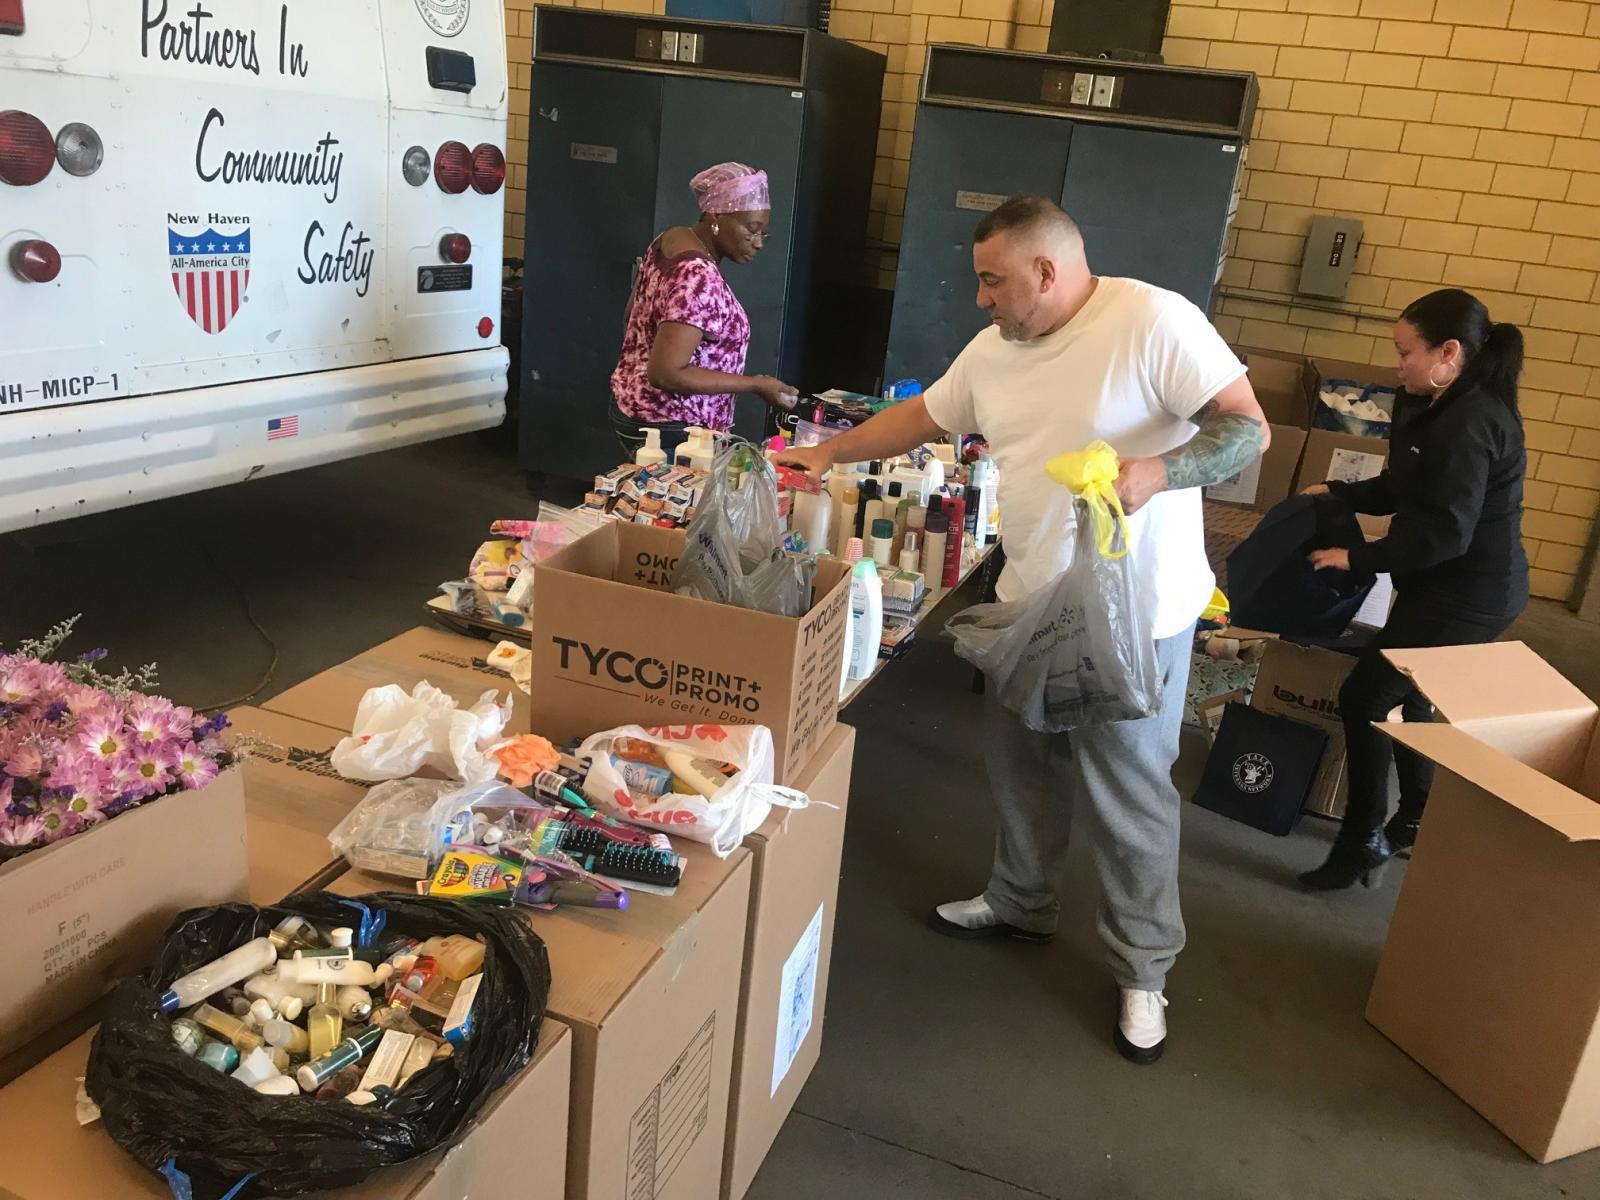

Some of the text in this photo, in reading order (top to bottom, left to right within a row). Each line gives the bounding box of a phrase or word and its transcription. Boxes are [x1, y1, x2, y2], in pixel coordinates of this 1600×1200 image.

[142, 0, 308, 78] Partners In
[195, 107, 343, 204] Community
[167, 212, 250, 224] New Haven
[171, 256, 250, 269] All-America City
[297, 220, 375, 298] Safety
[803, 603, 832, 647] TYCO
[552, 636, 669, 690] TYCO
[676, 663, 762, 694] PRINT+
[644, 692, 666, 707] We
[670, 699, 695, 714] Get
[674, 681, 760, 713] PROMO
[27, 857, 126, 915] HANDLE WITH CARE
[438, 859, 456, 885] Crayola
[58, 921, 67, 936] F
[88, 931, 108, 948] PCS
[45, 962, 74, 985] MADE
[77, 954, 87, 968] IN
